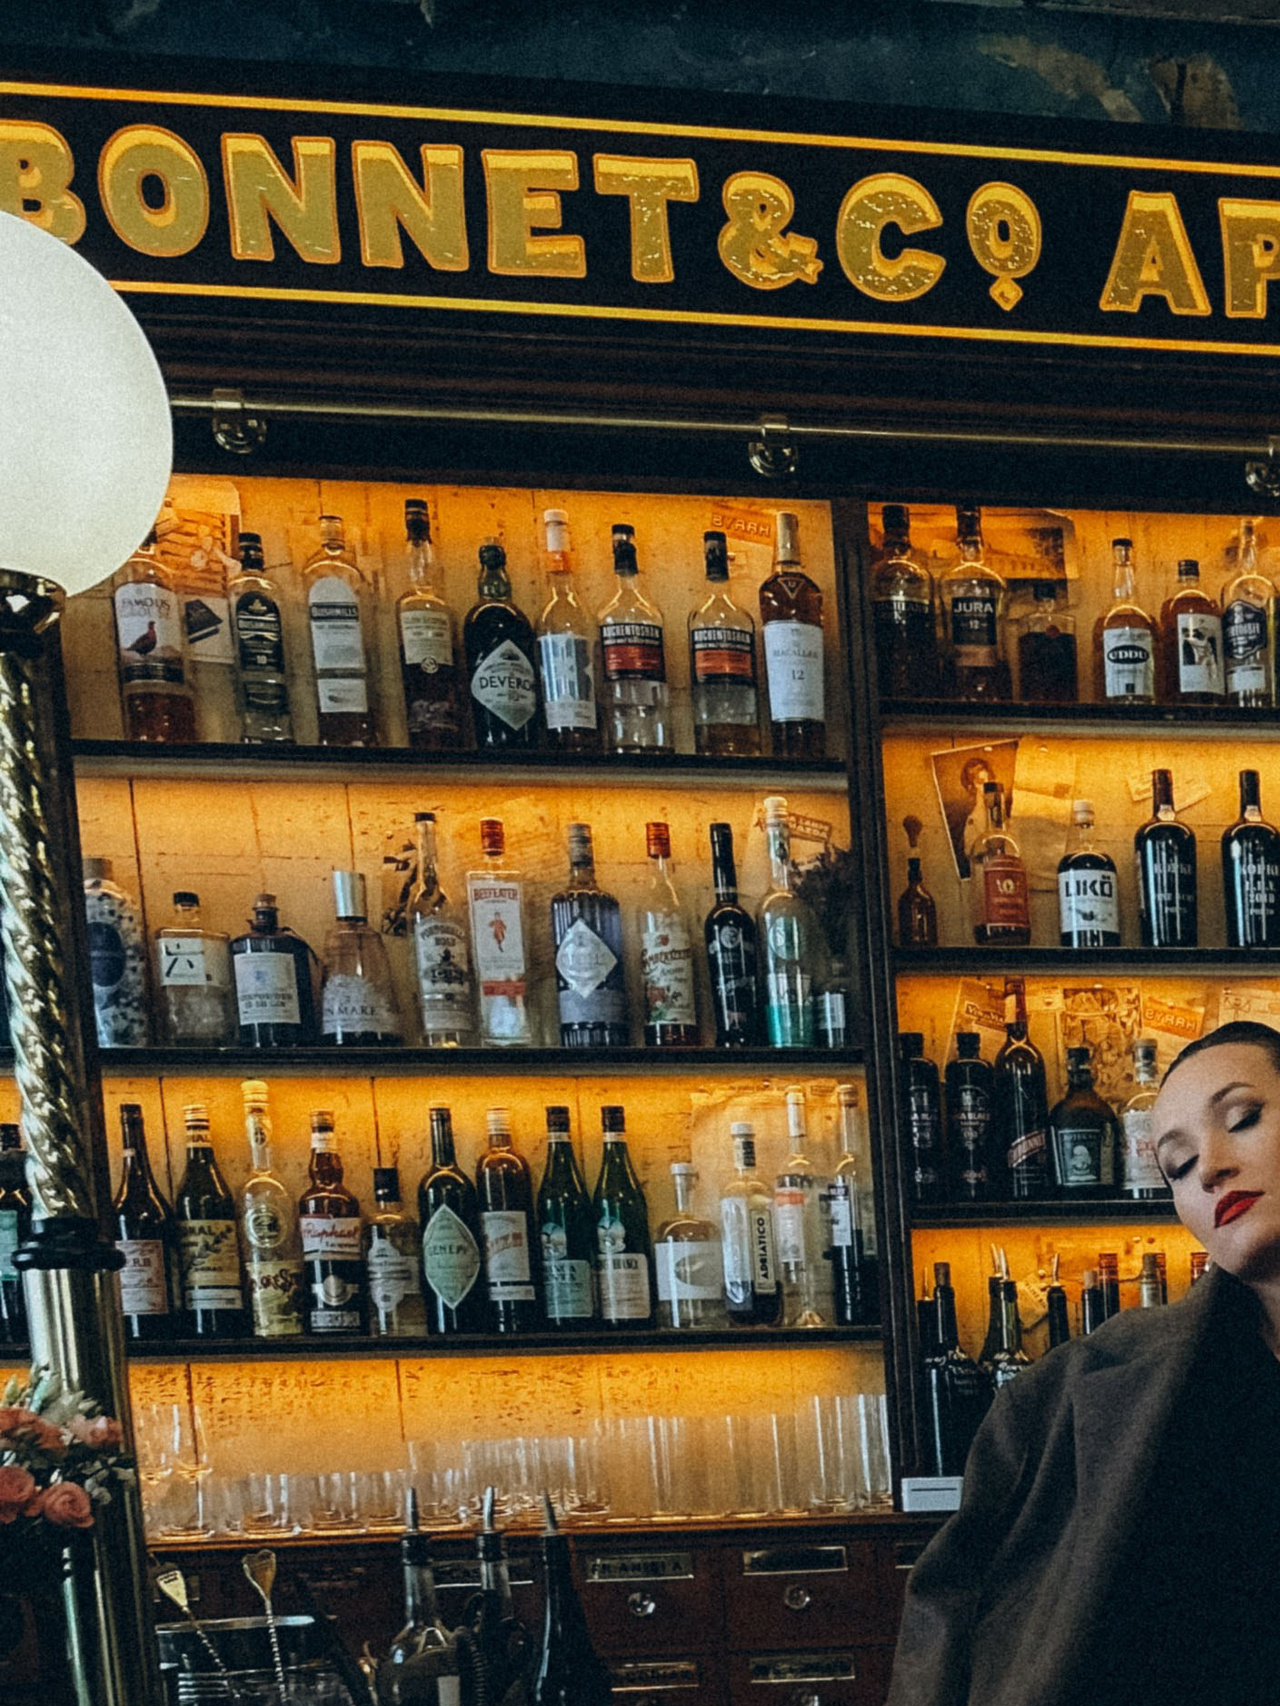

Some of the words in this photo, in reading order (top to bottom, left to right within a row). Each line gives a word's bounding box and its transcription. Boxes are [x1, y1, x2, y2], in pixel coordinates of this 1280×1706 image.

[0, 119, 700, 284] BONNET
[953, 601, 994, 614] JURA
[791, 669, 804, 681] 12
[473, 888, 518, 901] BEEFEATER
[164, 941, 205, 978] 六
[757, 1217, 769, 1279] ADRIATICO
